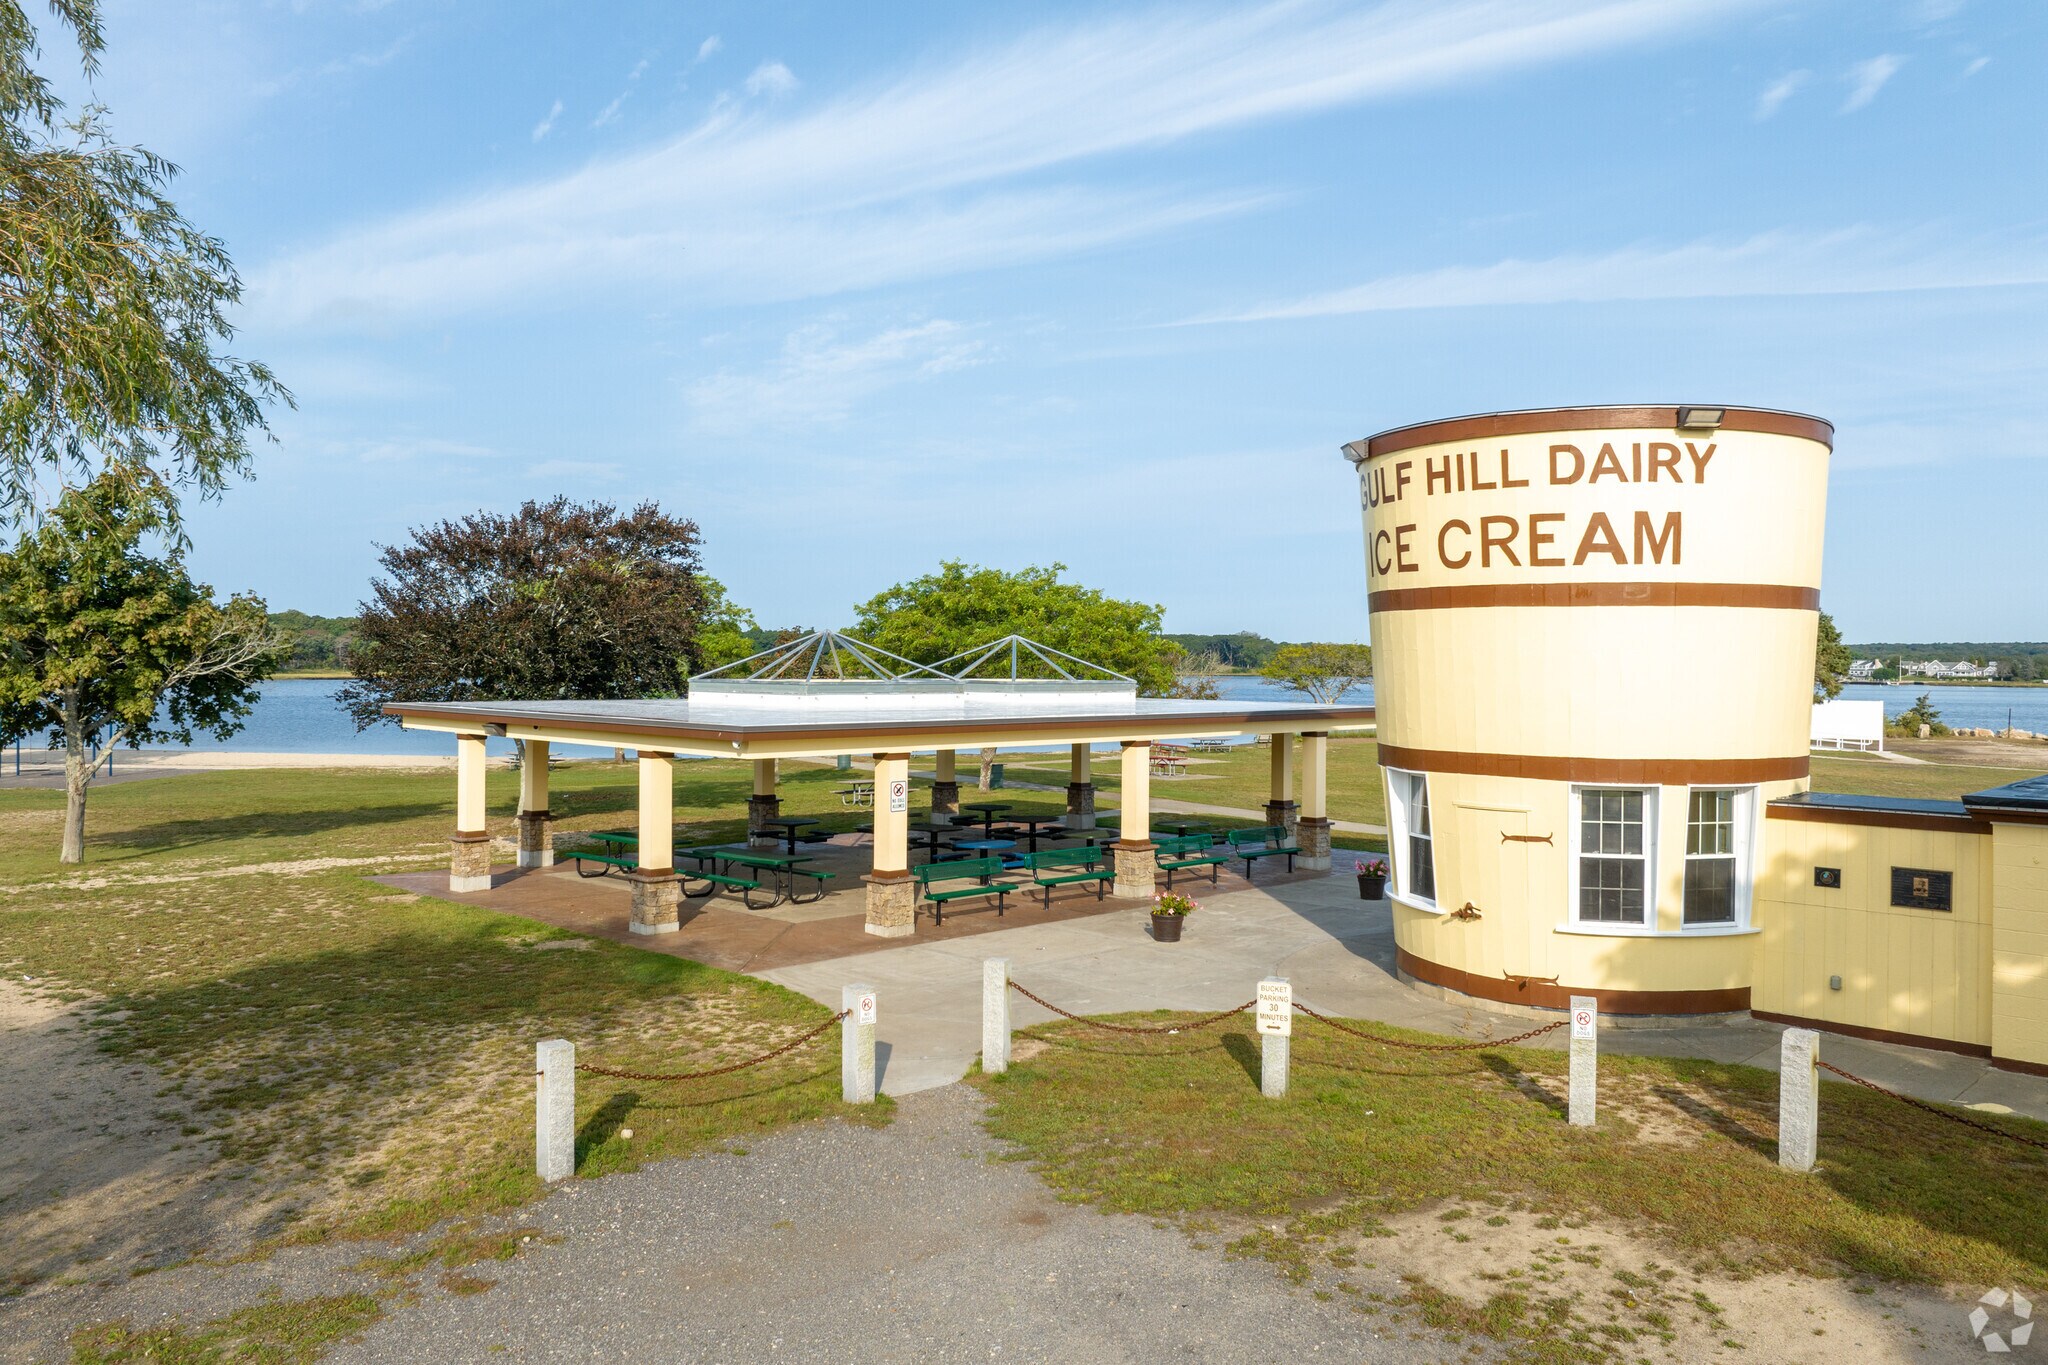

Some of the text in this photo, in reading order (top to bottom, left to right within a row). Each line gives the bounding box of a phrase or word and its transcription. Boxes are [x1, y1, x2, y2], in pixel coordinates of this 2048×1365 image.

[1360, 442, 1718, 511] GULF HILL DAIRY
[1369, 511, 1682, 578] ICE CREAM
[1260, 985, 1287, 993] BUCKET
[1260, 994, 1289, 1003] PARKING
[1269, 1003, 1279, 1012] 30
[1259, 1013, 1289, 1022] MINUTES
